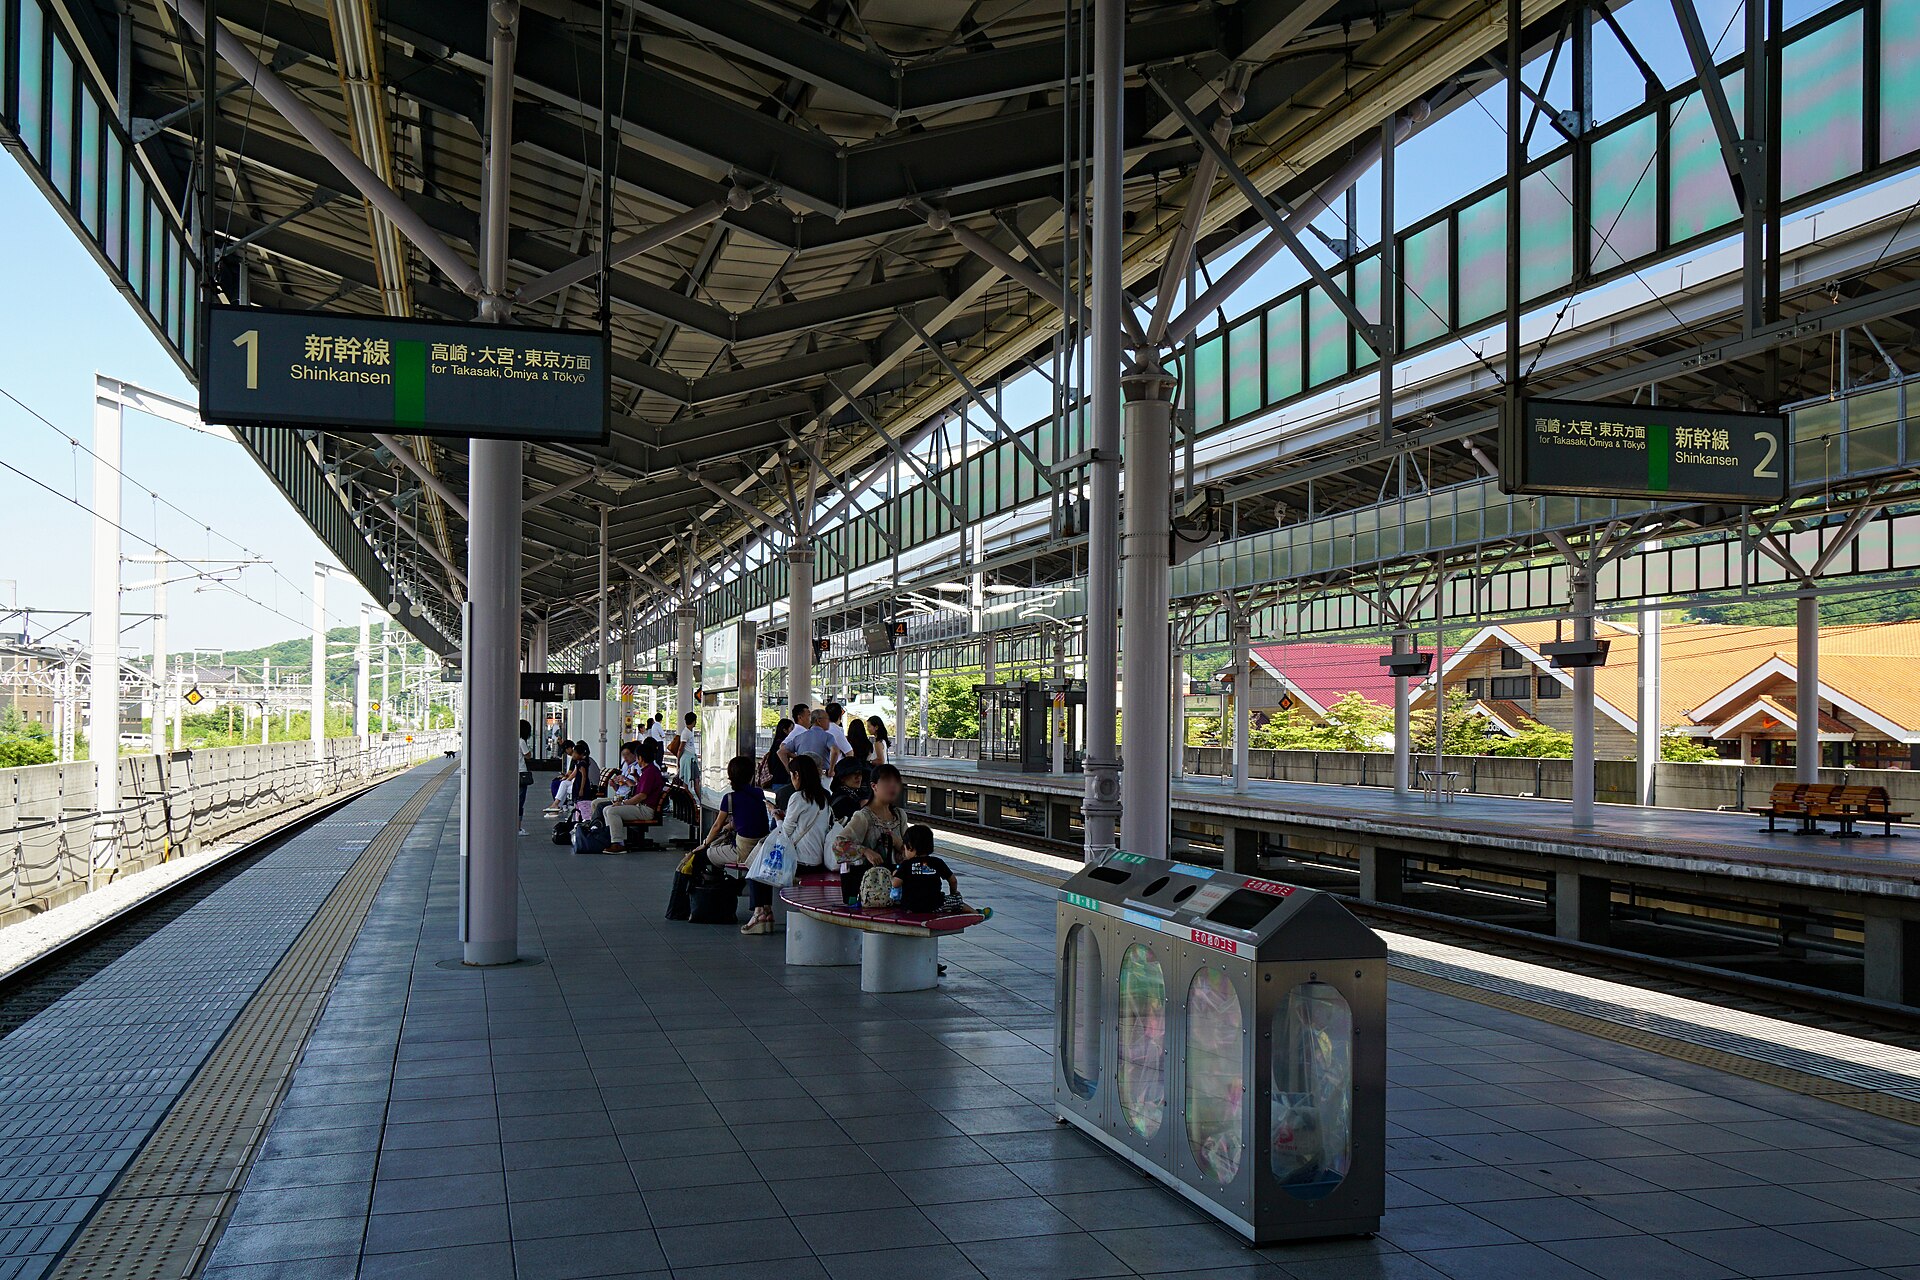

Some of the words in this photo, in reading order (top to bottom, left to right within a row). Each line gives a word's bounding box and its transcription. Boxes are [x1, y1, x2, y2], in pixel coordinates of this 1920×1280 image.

[232, 330, 258, 390] 1
[304, 333, 391, 366] 新幹線
[431, 343, 591, 370] 高崎・大宮・東京方面
[290, 364, 391, 385] Shinkansen
[431, 363, 447, 374] for
[451, 365, 501, 379] Takasaki,
[504, 366, 539, 381] Ōmiya
[542, 372, 549, 381] &
[553, 371, 586, 384] Tōkyō
[1535, 418, 1646, 439] 高崎・大宮・東京方面
[1675, 425, 1730, 451] 新幹線
[1539, 435, 1550, 444] for
[1553, 435, 1588, 447] Takasaki,
[1589, 436, 1613, 449] Ōmiya
[1622, 439, 1646, 451] Tōkyō
[1675, 450, 1739, 467] Shinkansen
[1753, 431, 1779, 478] 2
[896, 623, 904, 634] 4
[821, 640, 828, 650] 3
[1225, 683, 1232, 693] 4
